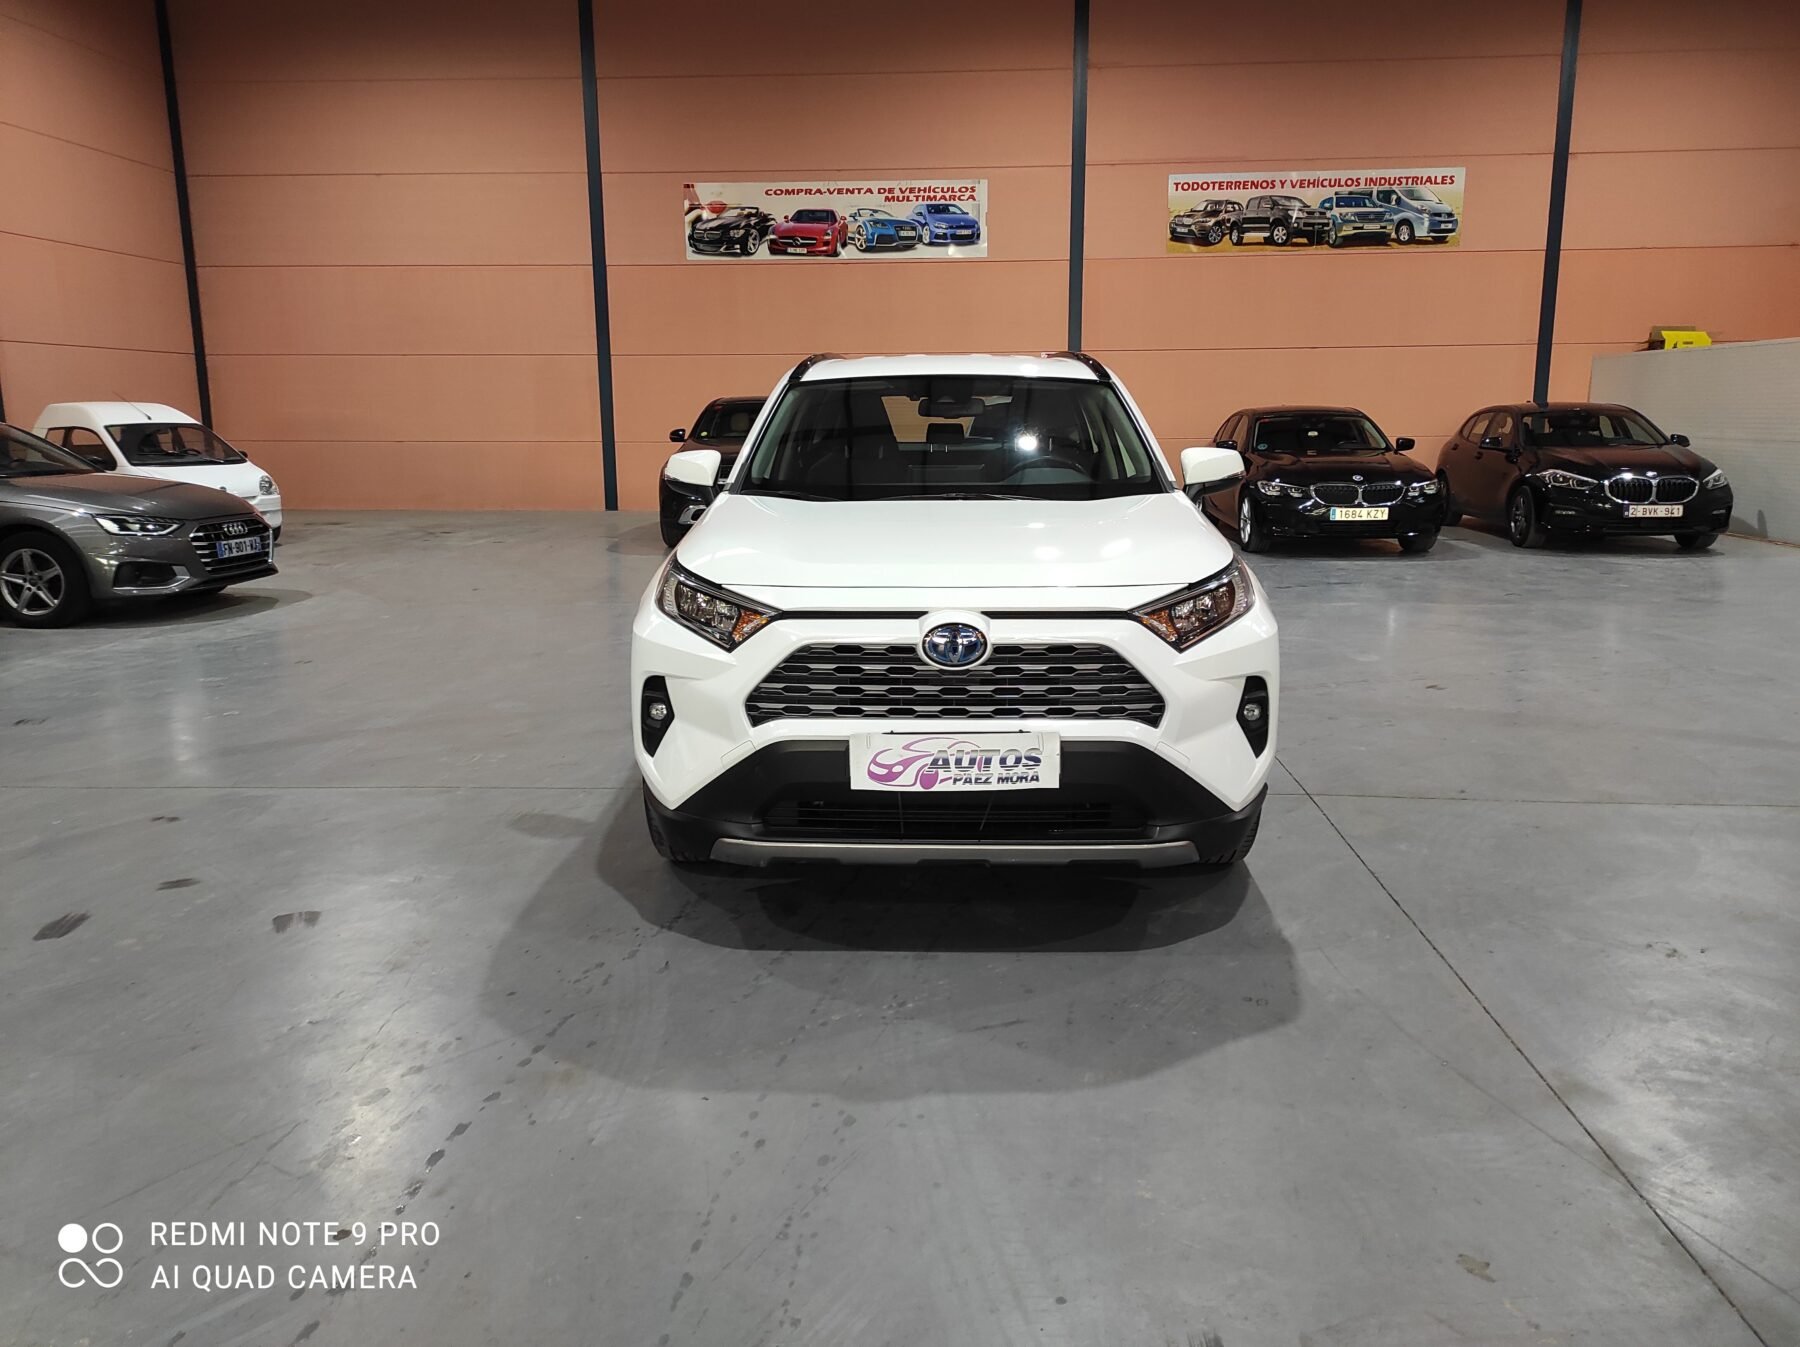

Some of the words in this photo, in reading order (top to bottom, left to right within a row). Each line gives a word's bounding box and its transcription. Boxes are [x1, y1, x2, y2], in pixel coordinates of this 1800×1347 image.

[1173, 180, 1276, 192] TODOTERRENOS
[1278, 180, 1287, 190] Y
[1290, 176, 1361, 189] VEHÍCULOS
[1364, 175, 1455, 187] INDUSTRIALES
[765, 187, 873, 196] COMPRA-VENTA
[877, 187, 895, 195] DE
[899, 185, 977, 194] VEHÍCULOS
[884, 194, 977, 202] MULTIMARCA
[1339, 510, 1363, 519] 1684
[1366, 510, 1386, 518] KZY
[926, 748, 1042, 773] AUTOS
[997, 773, 1041, 785] MORA
